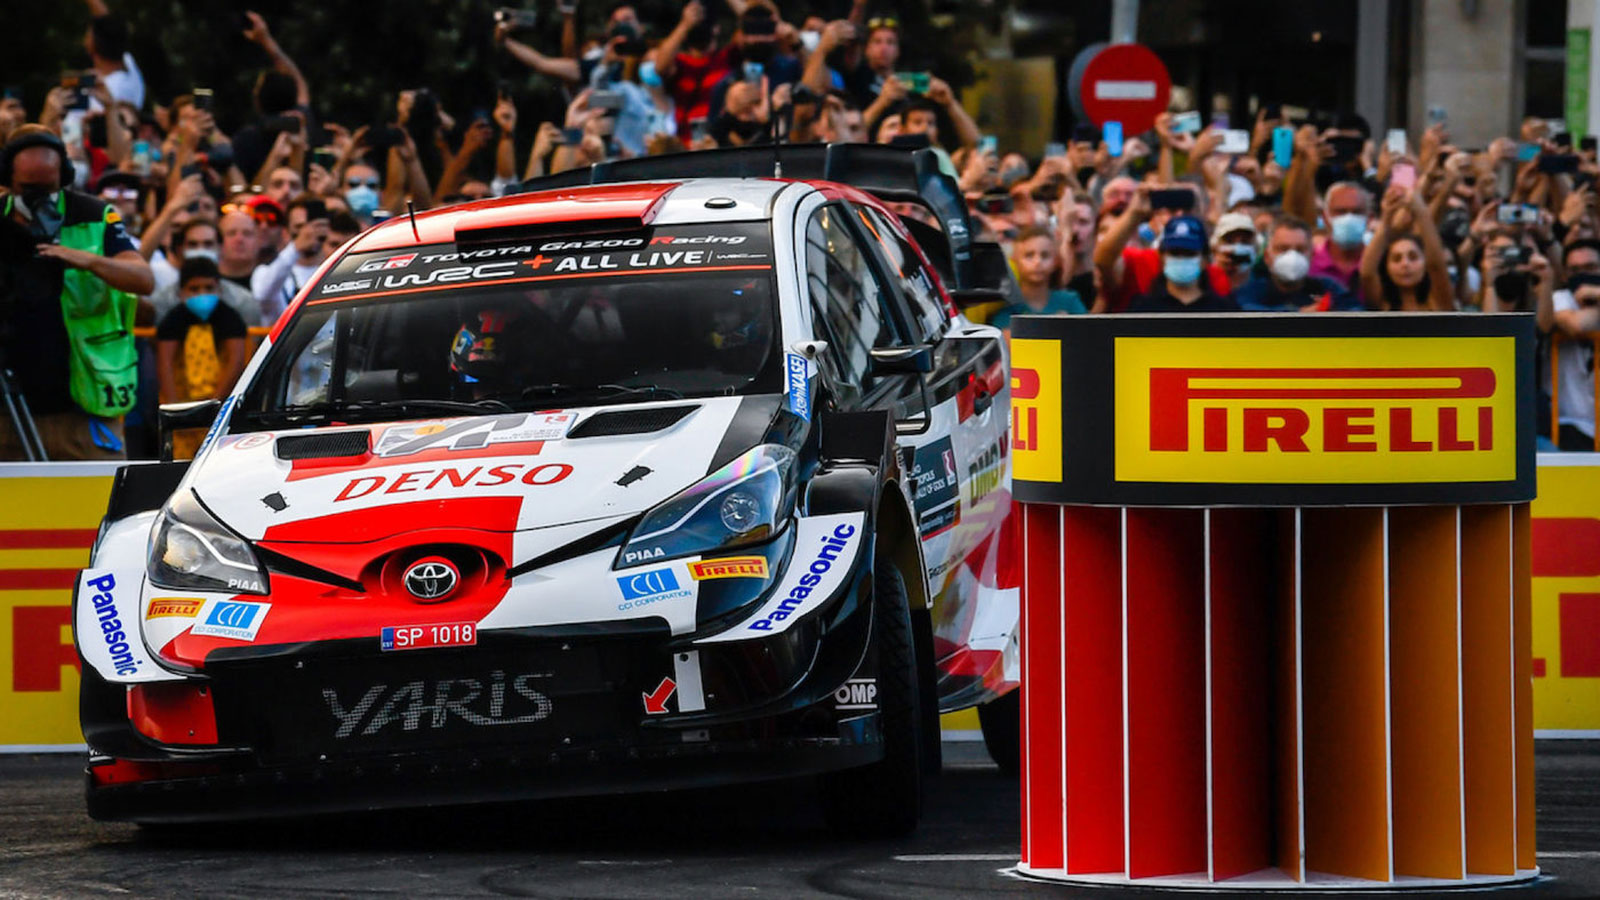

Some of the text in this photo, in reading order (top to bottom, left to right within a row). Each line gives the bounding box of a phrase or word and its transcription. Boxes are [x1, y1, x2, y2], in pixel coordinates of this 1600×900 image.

[422, 235, 747, 263] TOYOTA GAZOO Racing
[554, 255, 618, 272] ALL
[629, 251, 704, 267] LIVE
[1149, 367, 1497, 452] PIRELLI
[333, 463, 574, 502] DENSO
[625, 547, 666, 563] PIAA
[693, 559, 763, 577] PIRELLI
[747, 523, 855, 632] Panasonic
[228, 578, 259, 590] PIAA
[149, 600, 200, 616] PIRELLI
[634, 590, 693, 607] CORPORATION
[87, 573, 143, 676] Panasonic
[396, 628, 423, 646] SP
[431, 624, 473, 644] 1018
[322, 670, 555, 738] YARIS
[834, 682, 877, 704] OMP
